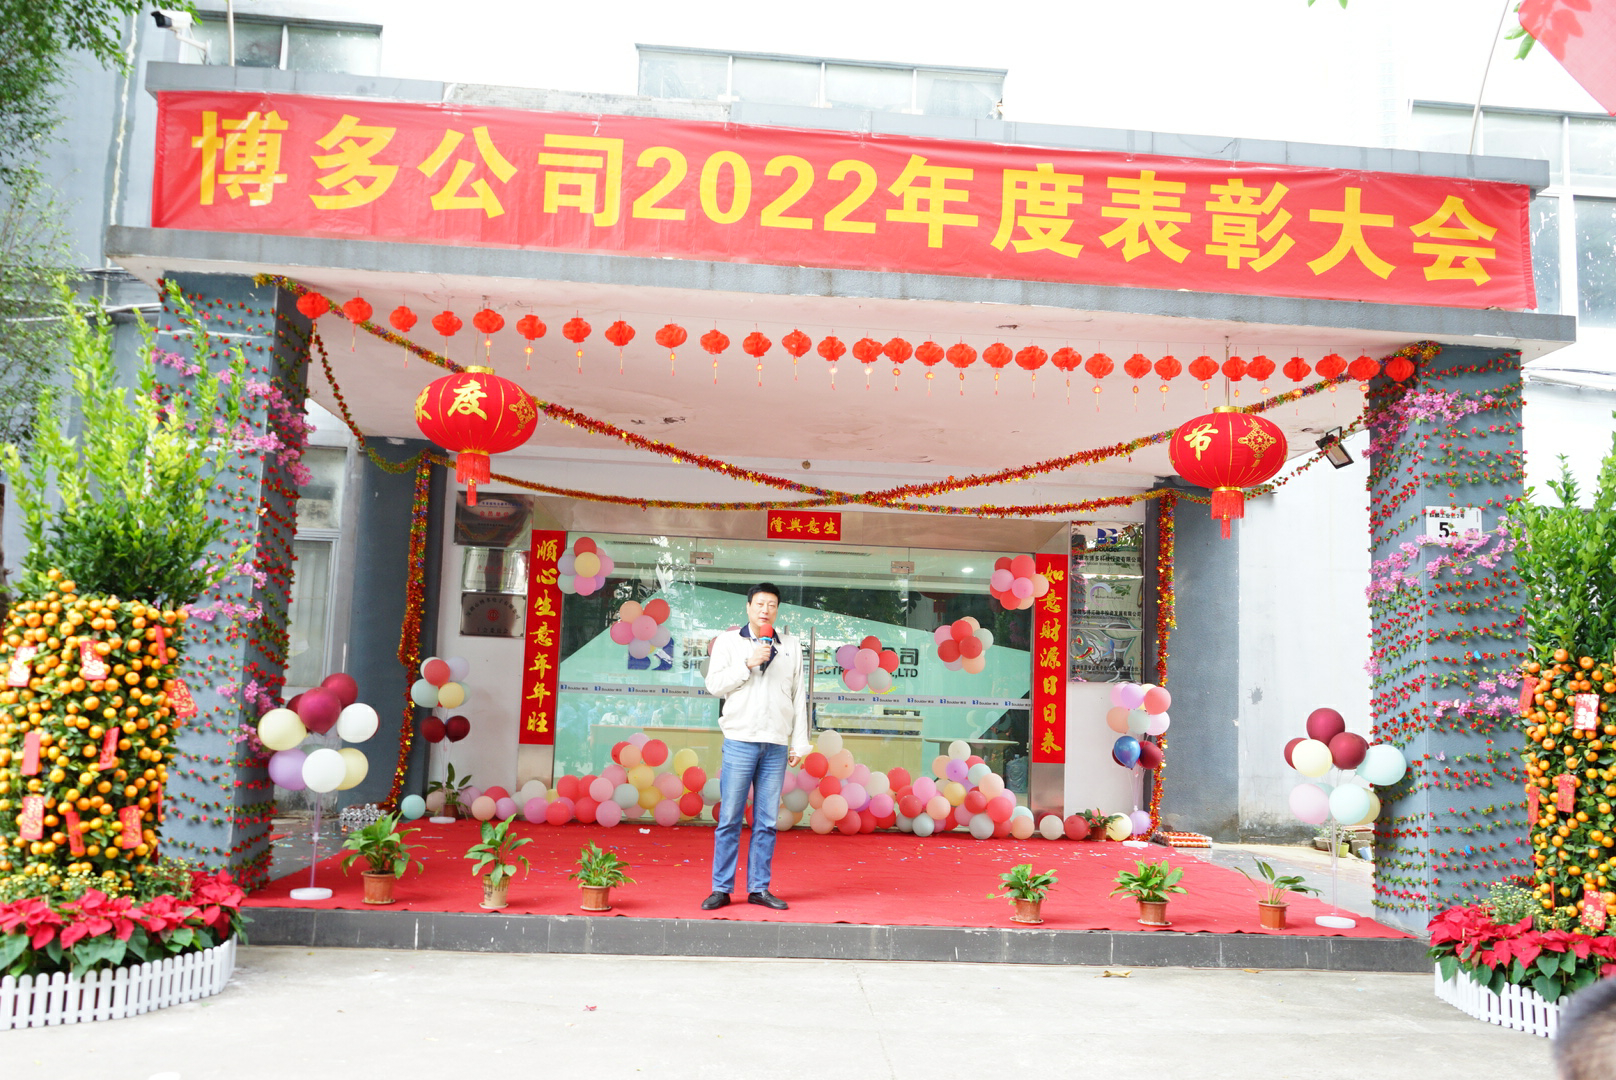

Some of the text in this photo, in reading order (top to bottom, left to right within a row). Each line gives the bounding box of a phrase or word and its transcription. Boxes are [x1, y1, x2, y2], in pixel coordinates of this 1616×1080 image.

[191, 109, 1499, 287] 博多公司2022年度表彰大会
